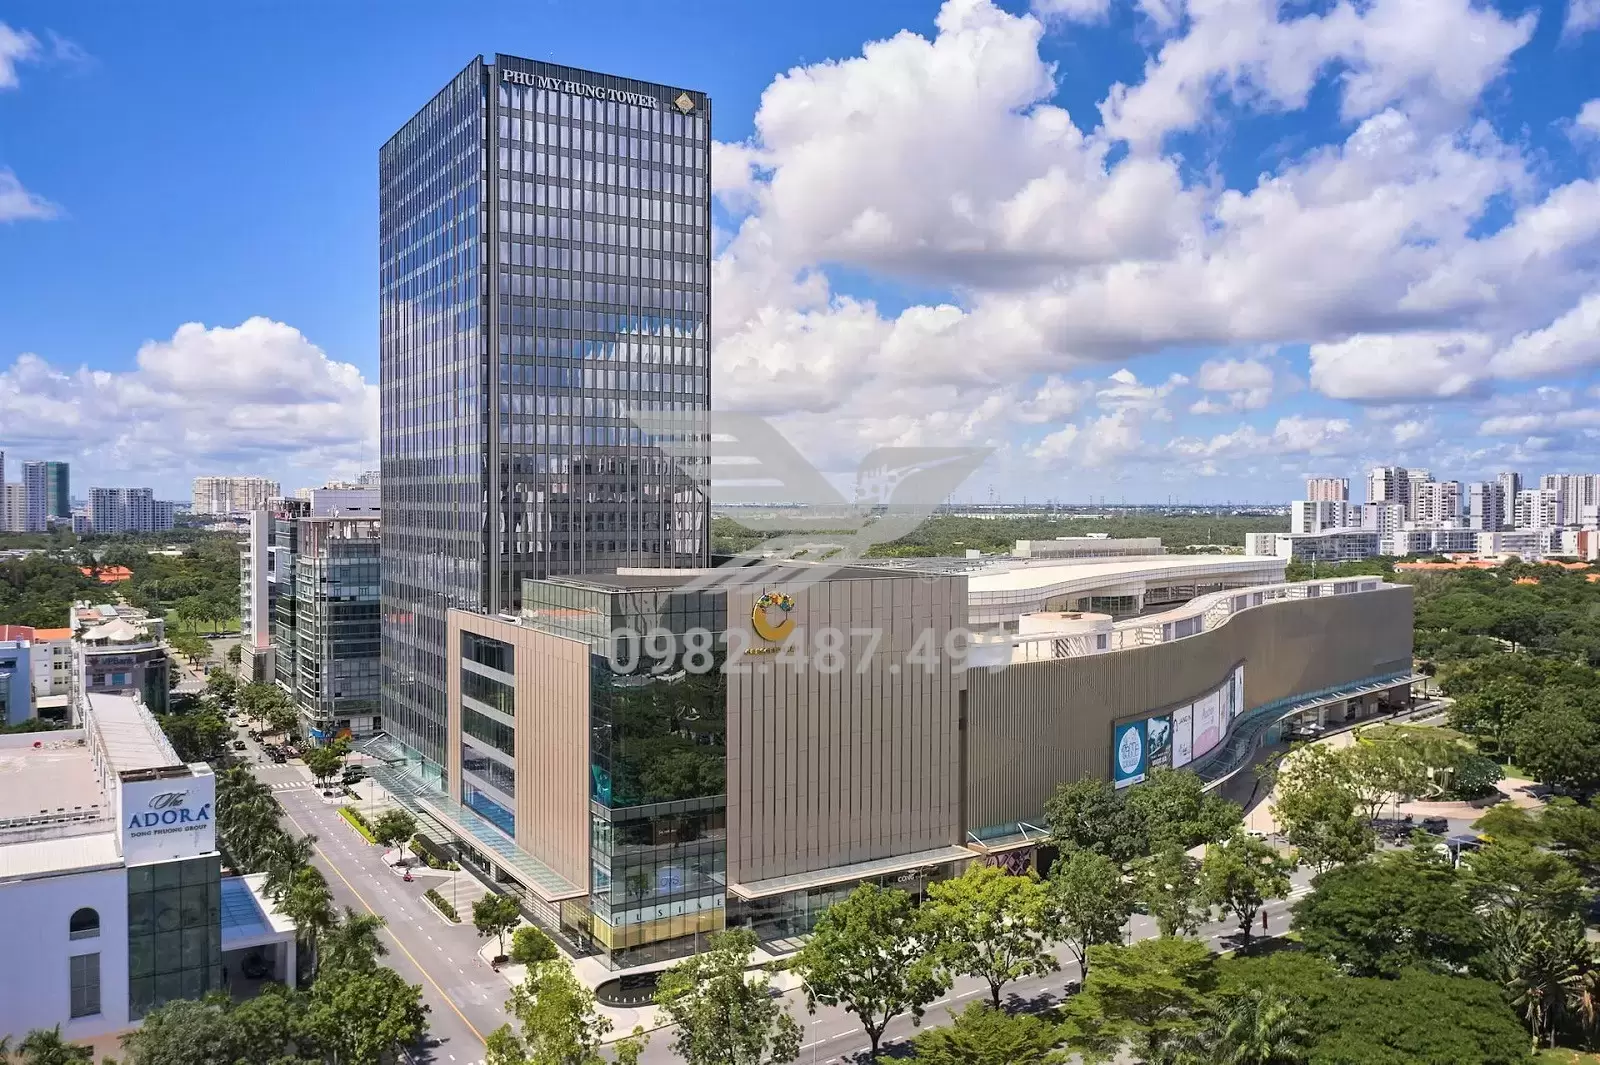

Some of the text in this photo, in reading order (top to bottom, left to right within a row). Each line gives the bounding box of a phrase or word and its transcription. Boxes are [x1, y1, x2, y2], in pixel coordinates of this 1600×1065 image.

[503, 68, 657, 108] PHU MY HUNG TOWER
[148, 790, 188, 810] The
[128, 805, 210, 829] ADORA
[131, 830, 152, 838] DONG
[184, 824, 207, 832] GROUP
